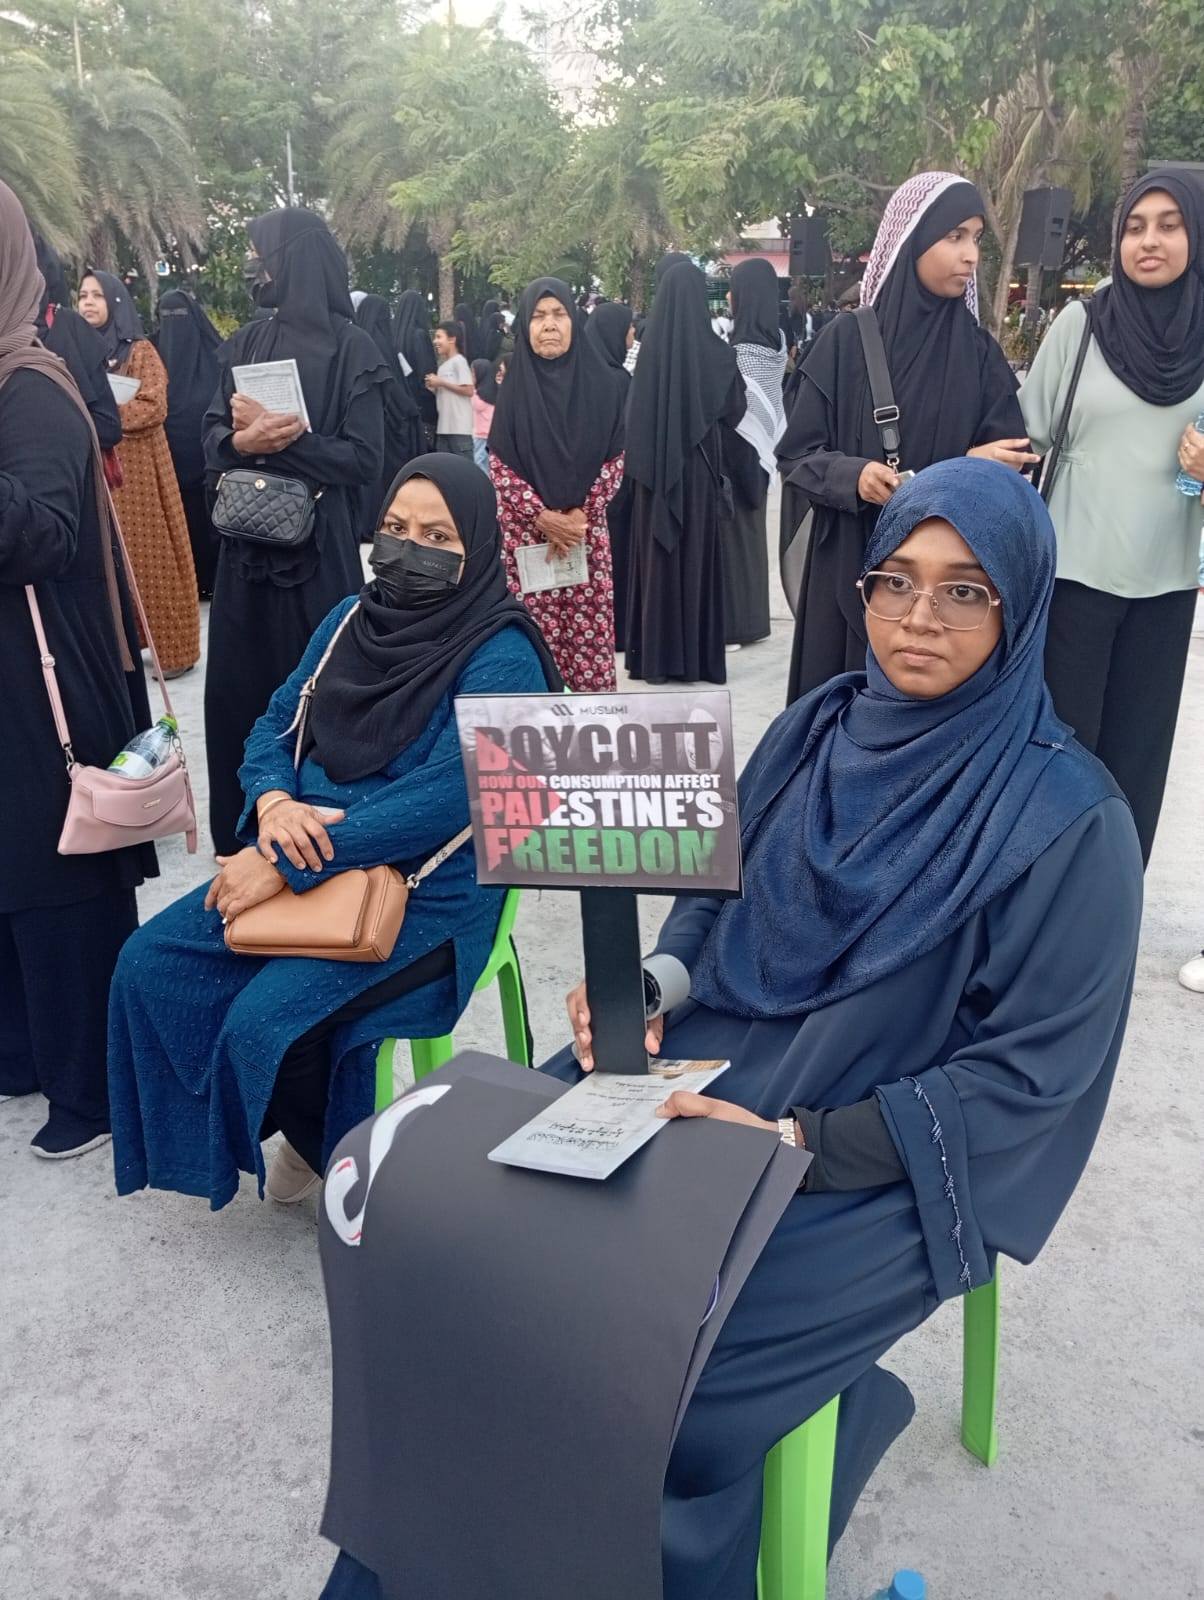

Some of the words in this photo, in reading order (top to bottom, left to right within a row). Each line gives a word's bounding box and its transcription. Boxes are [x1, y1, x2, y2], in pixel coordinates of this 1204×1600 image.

[474, 722, 718, 772] BOYCOTT
[478, 775, 513, 789] HOW
[516, 775, 547, 789] OUR
[550, 775, 662, 789] CONSUMPTION
[664, 774, 720, 789] AFFECT
[481, 790, 724, 828] PALESTINE'S
[484, 828, 719, 876] FREEDOM
